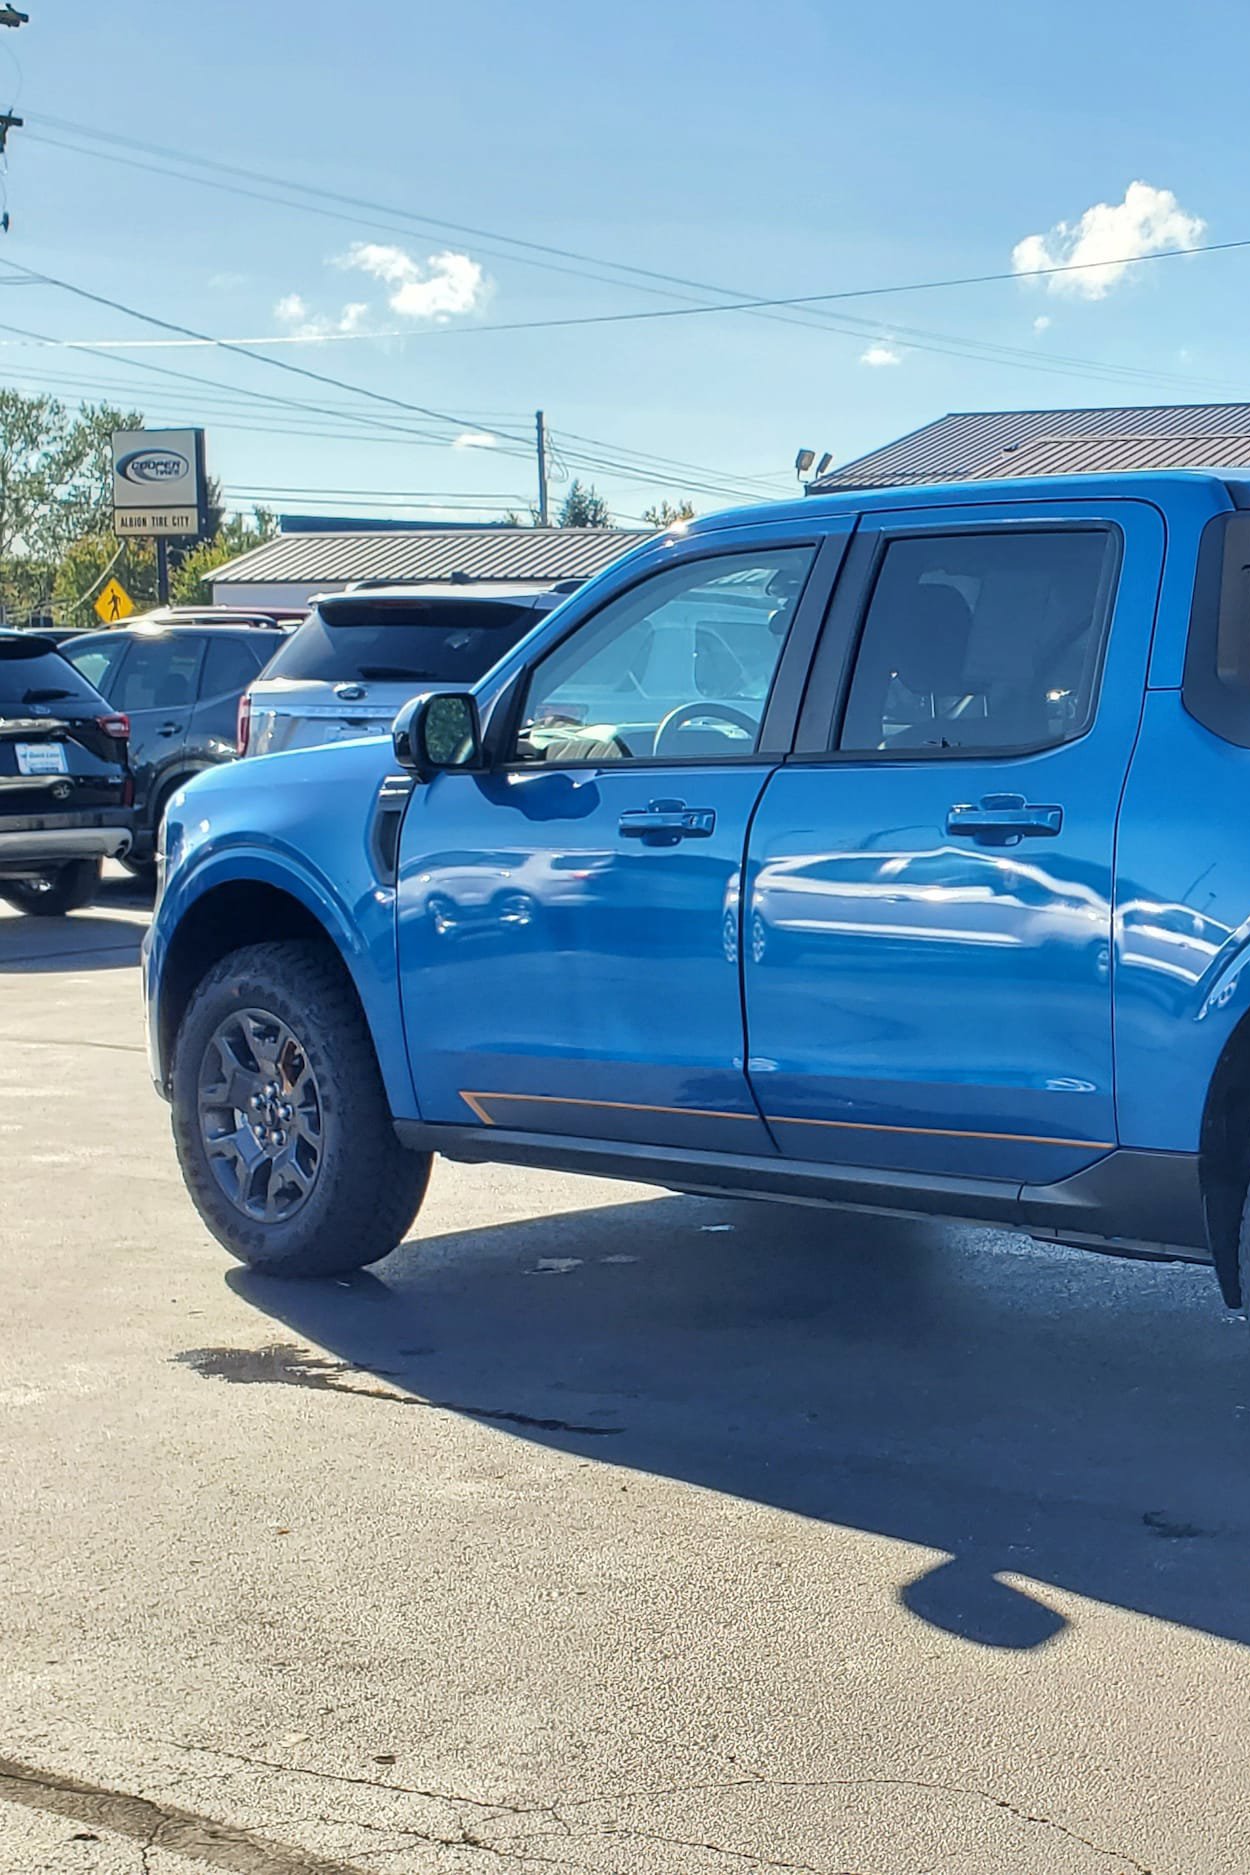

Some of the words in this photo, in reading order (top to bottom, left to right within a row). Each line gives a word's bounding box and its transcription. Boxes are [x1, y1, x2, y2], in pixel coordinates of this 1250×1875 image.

[120, 516, 147, 528] ALBION
[152, 516, 168, 527] TIRE
[172, 515, 189, 527] CITY
